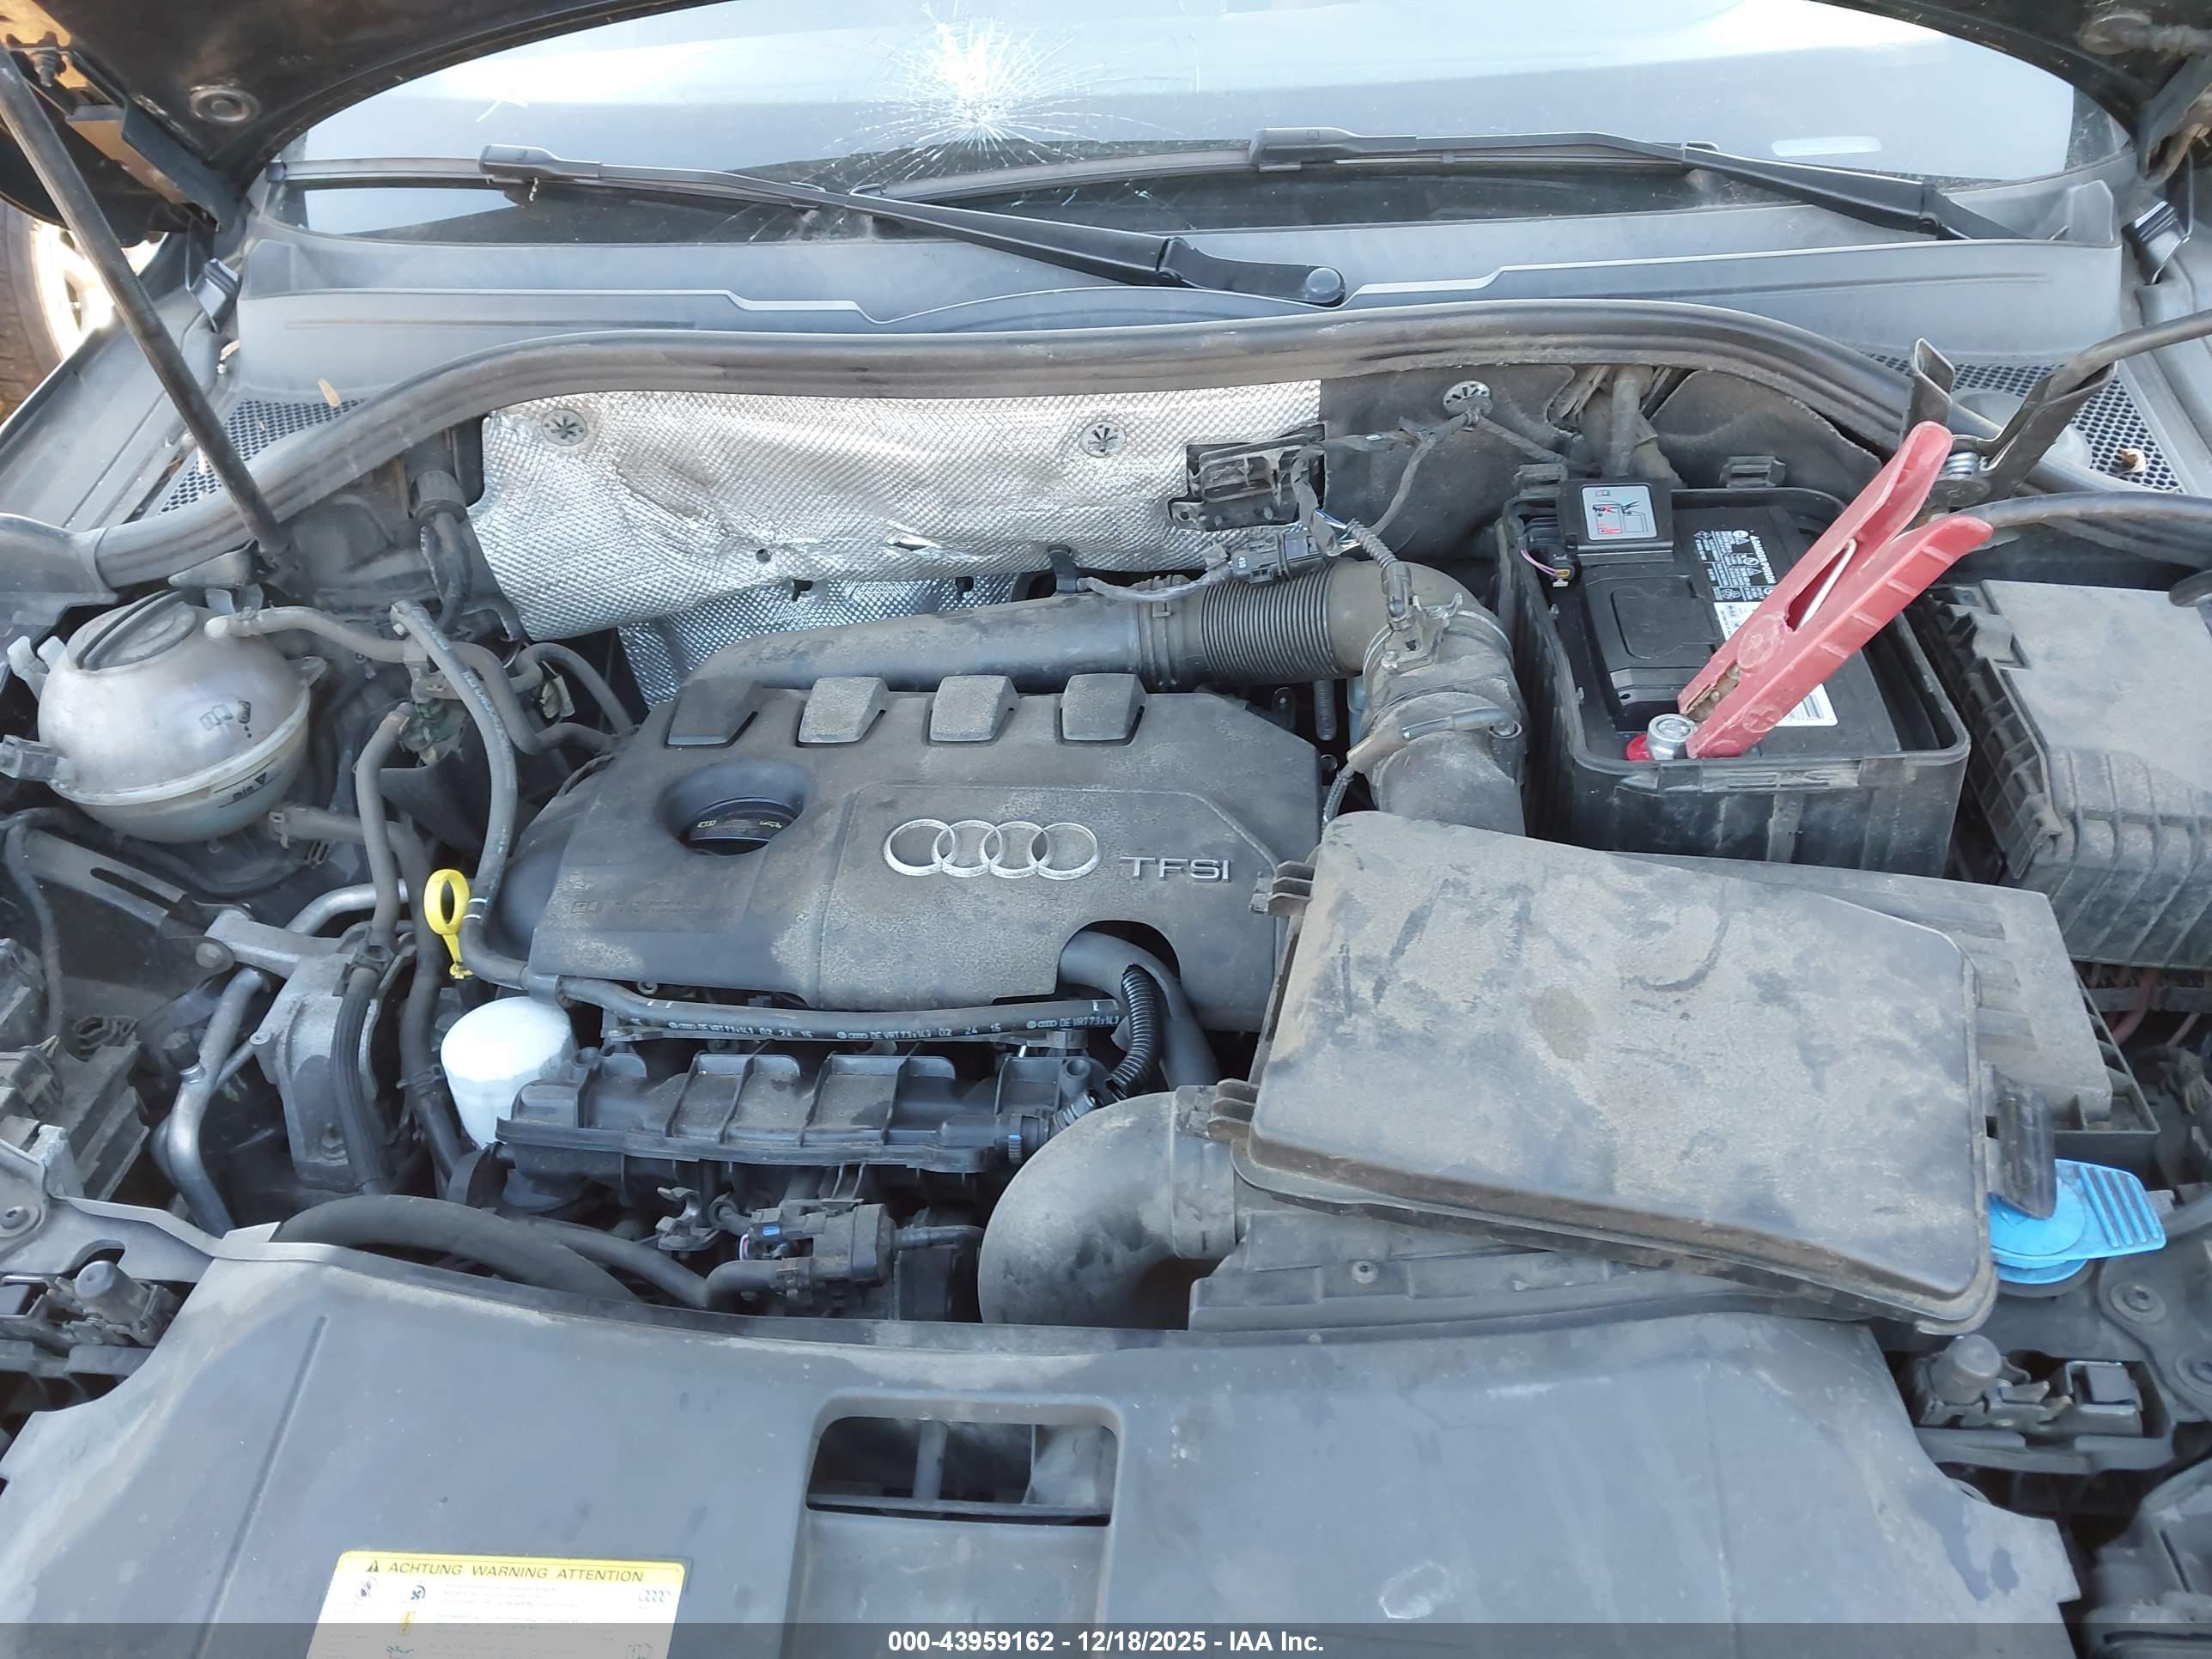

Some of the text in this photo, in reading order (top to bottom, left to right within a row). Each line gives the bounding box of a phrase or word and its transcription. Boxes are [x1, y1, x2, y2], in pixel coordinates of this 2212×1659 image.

[1752, 540, 1777, 584] DANGER POISON
[1119, 856, 1230, 880] TFSI
[388, 1562, 644, 1583] ACHTUNG WARNING ATTENTION
